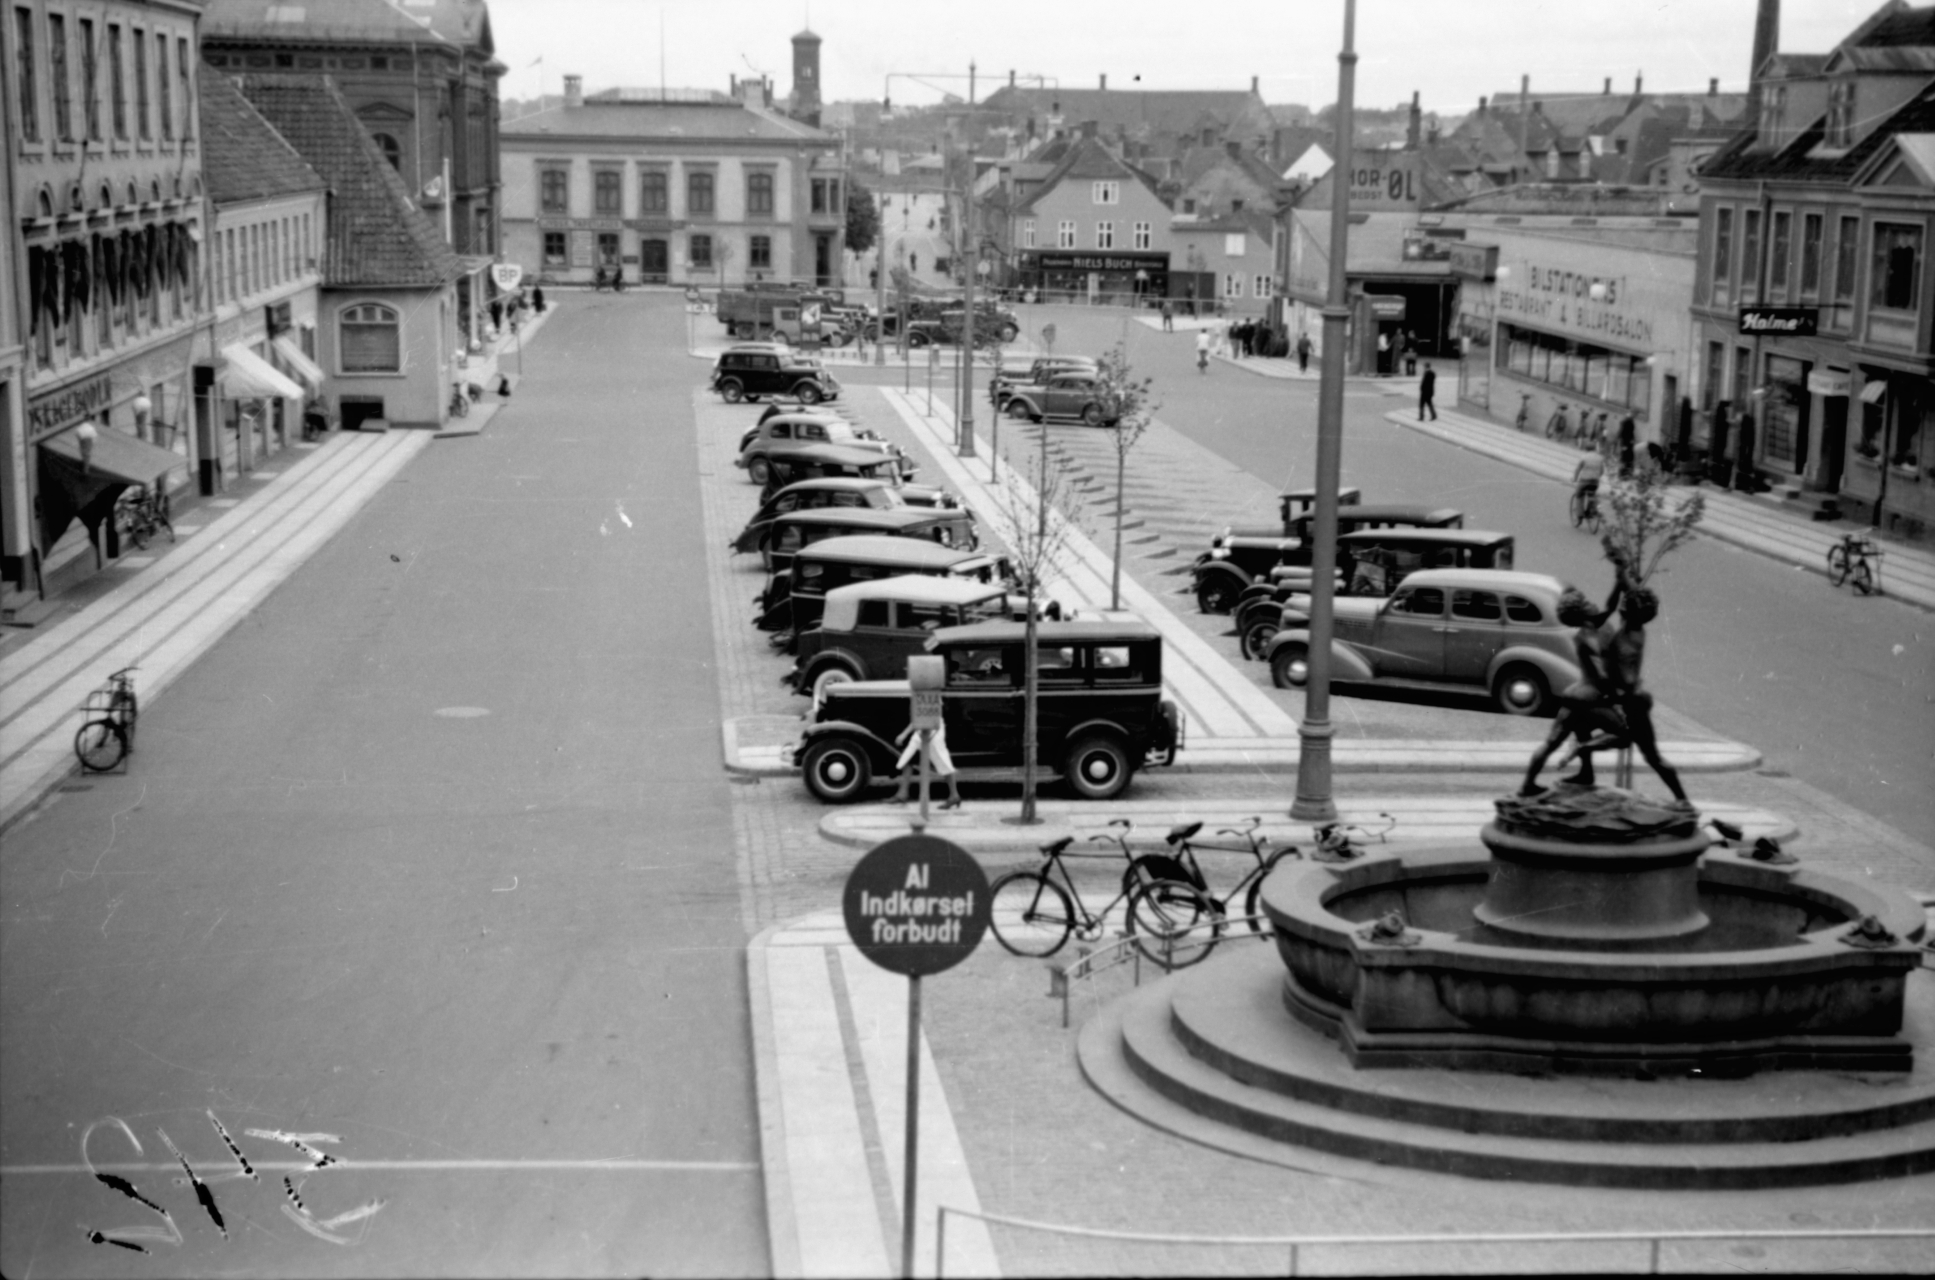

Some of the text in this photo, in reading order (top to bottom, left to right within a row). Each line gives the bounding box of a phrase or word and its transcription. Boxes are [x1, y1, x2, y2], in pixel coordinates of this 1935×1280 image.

[499, 269, 517, 282] BP
[1073, 257, 1103, 269] NIELS
[1105, 257, 1133, 269] BUCH
[905, 863, 930, 889] Al
[861, 890, 974, 916] Indkørsel
[871, 917, 962, 943] forbudt
